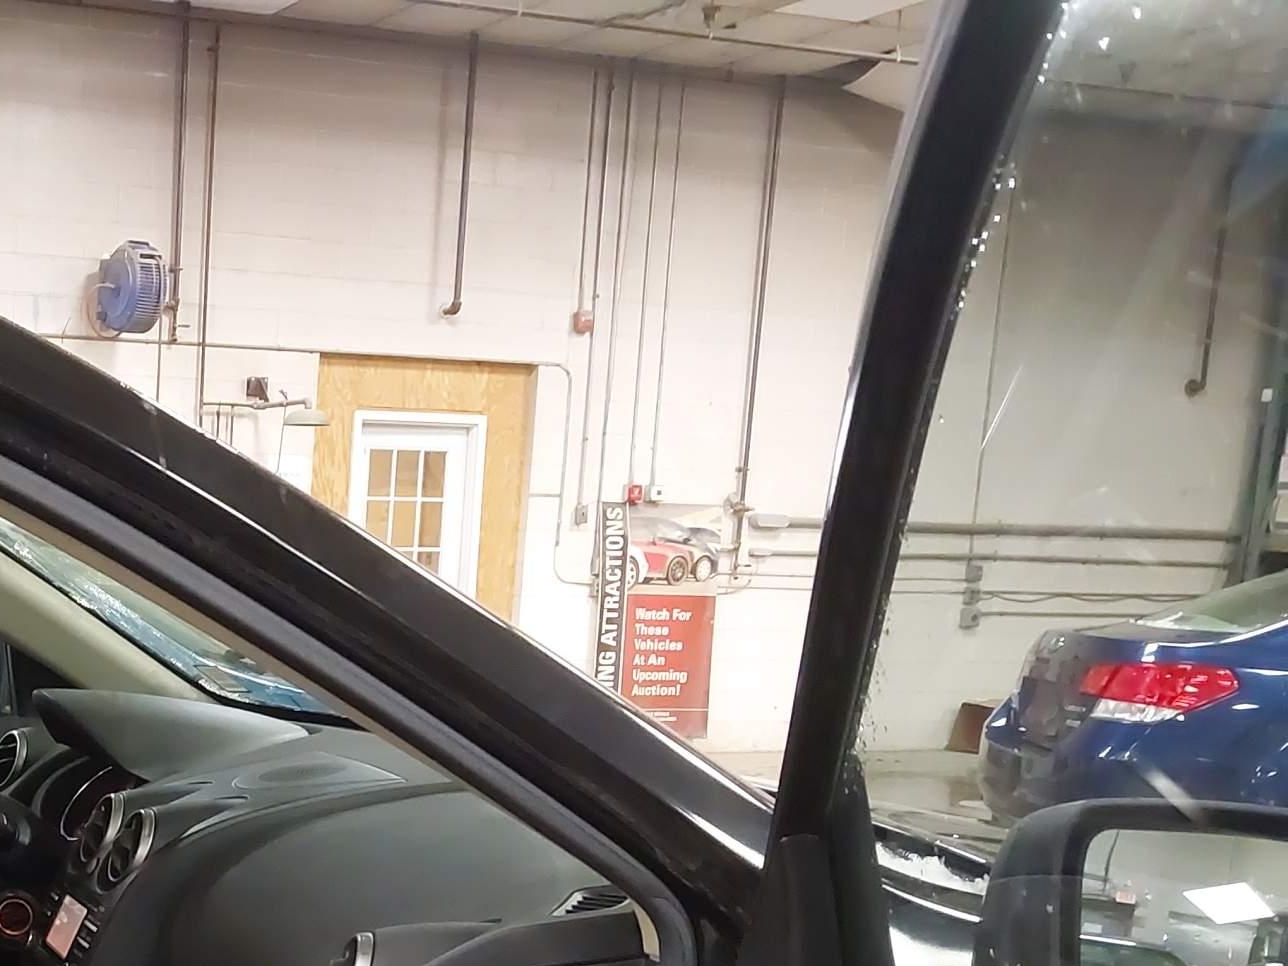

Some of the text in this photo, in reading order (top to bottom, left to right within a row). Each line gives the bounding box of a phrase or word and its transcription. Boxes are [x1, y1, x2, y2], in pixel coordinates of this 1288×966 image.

[601, 507, 625, 646] ATTRACTIONS
[635, 607, 693, 621] Watch For
[635, 623, 669, 636] These
[634, 638, 683, 651] Vehicles
[632, 654, 665, 666] At An
[632, 669, 688, 683] Upcoming
[631, 684, 681, 697] Auction!
